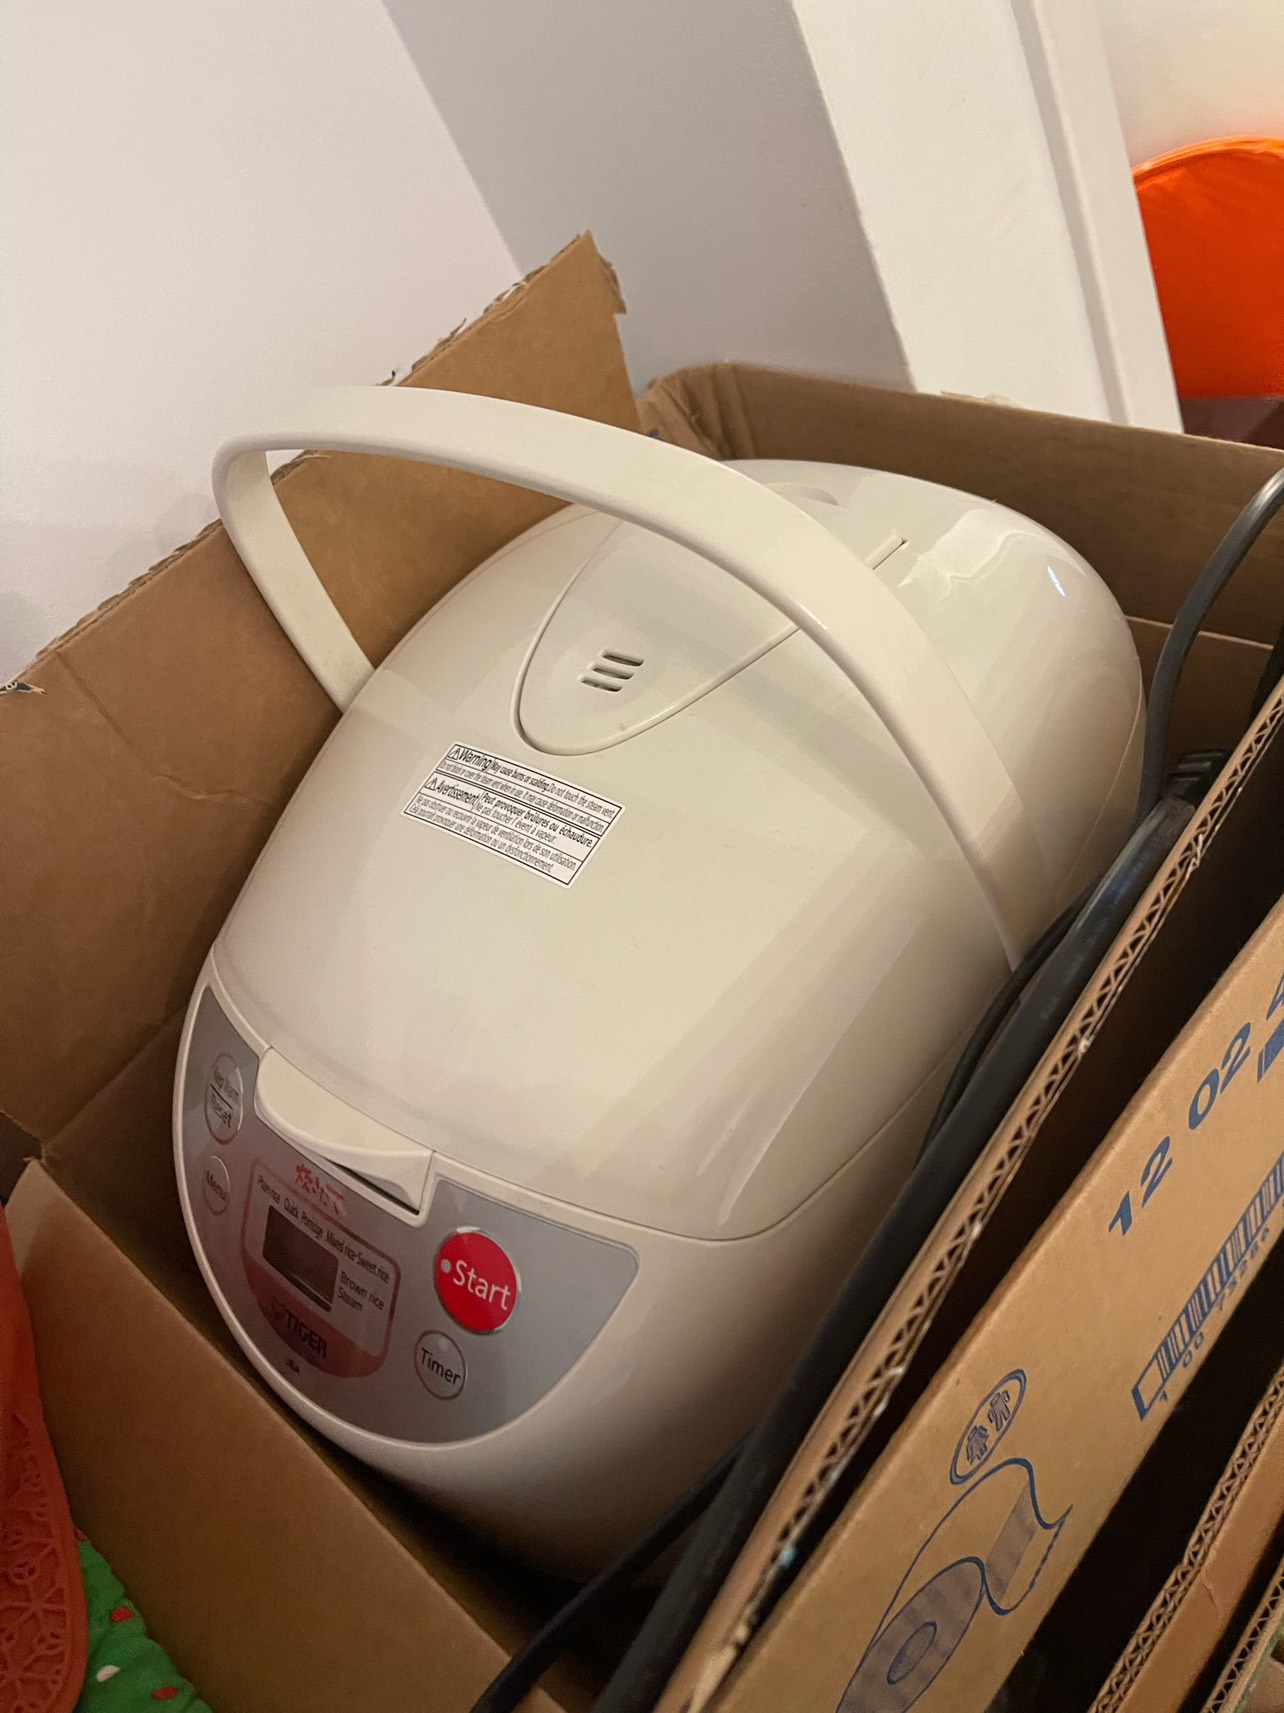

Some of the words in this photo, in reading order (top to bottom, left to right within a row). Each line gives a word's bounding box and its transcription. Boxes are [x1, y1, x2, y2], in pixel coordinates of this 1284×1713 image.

[436, 781, 478, 803] Avertissement
[459, 748, 491, 769] Warning
[490, 761, 500, 773] May
[499, 767, 512, 775] cause
[511, 769, 525, 780] burns
[554, 788, 565, 796] not
[563, 790, 579, 802] touch
[577, 796, 587, 806] the
[585, 801, 602, 812] steam
[601, 808, 614, 817] vent.
[473, 773, 481, 781] the
[480, 776, 492, 784] steam
[491, 780, 501, 788] vent
[526, 794, 536, 802] may
[534, 798, 548, 807] cause
[547, 802, 572, 817] deformation
[577, 816, 603, 831] malfunction.
[476, 802, 483, 811] Ne
[480, 806, 492, 815] pas
[491, 809, 512, 823] toucher
[535, 830, 555, 842] vapeur.
[481, 792, 495, 804] Peut
[493, 800, 524, 816] provoquer
[524, 810, 549, 826] brûlures
[549, 823, 558, 831] ou
[559, 827, 595, 846] échaudure.
[475, 820, 492, 830] vapeur
[490, 825, 499, 834] de
[498, 830, 523, 844] ventilation
[523, 838, 533, 849] lors
[532, 844, 541, 853] de
[539, 848, 550, 857] son
[550, 853, 575, 869] utilisation.
[505, 845, 552, 871] dysfonctionnement.
[1108, 1136, 1172, 1237] 12
[1188, 1021, 1251, 1131] 02
[206, 1170, 227, 1202] Menu
[283, 1196, 299, 1219] Quick
[301, 1210, 324, 1239] Porridge
[338, 1286, 364, 1313] Steam
[340, 1270, 368, 1298] Brown
[368, 1291, 385, 1310] rice
[453, 1259, 511, 1311] Start
[286, 1309, 327, 1359] TIGER
[421, 1347, 461, 1386] Timer
